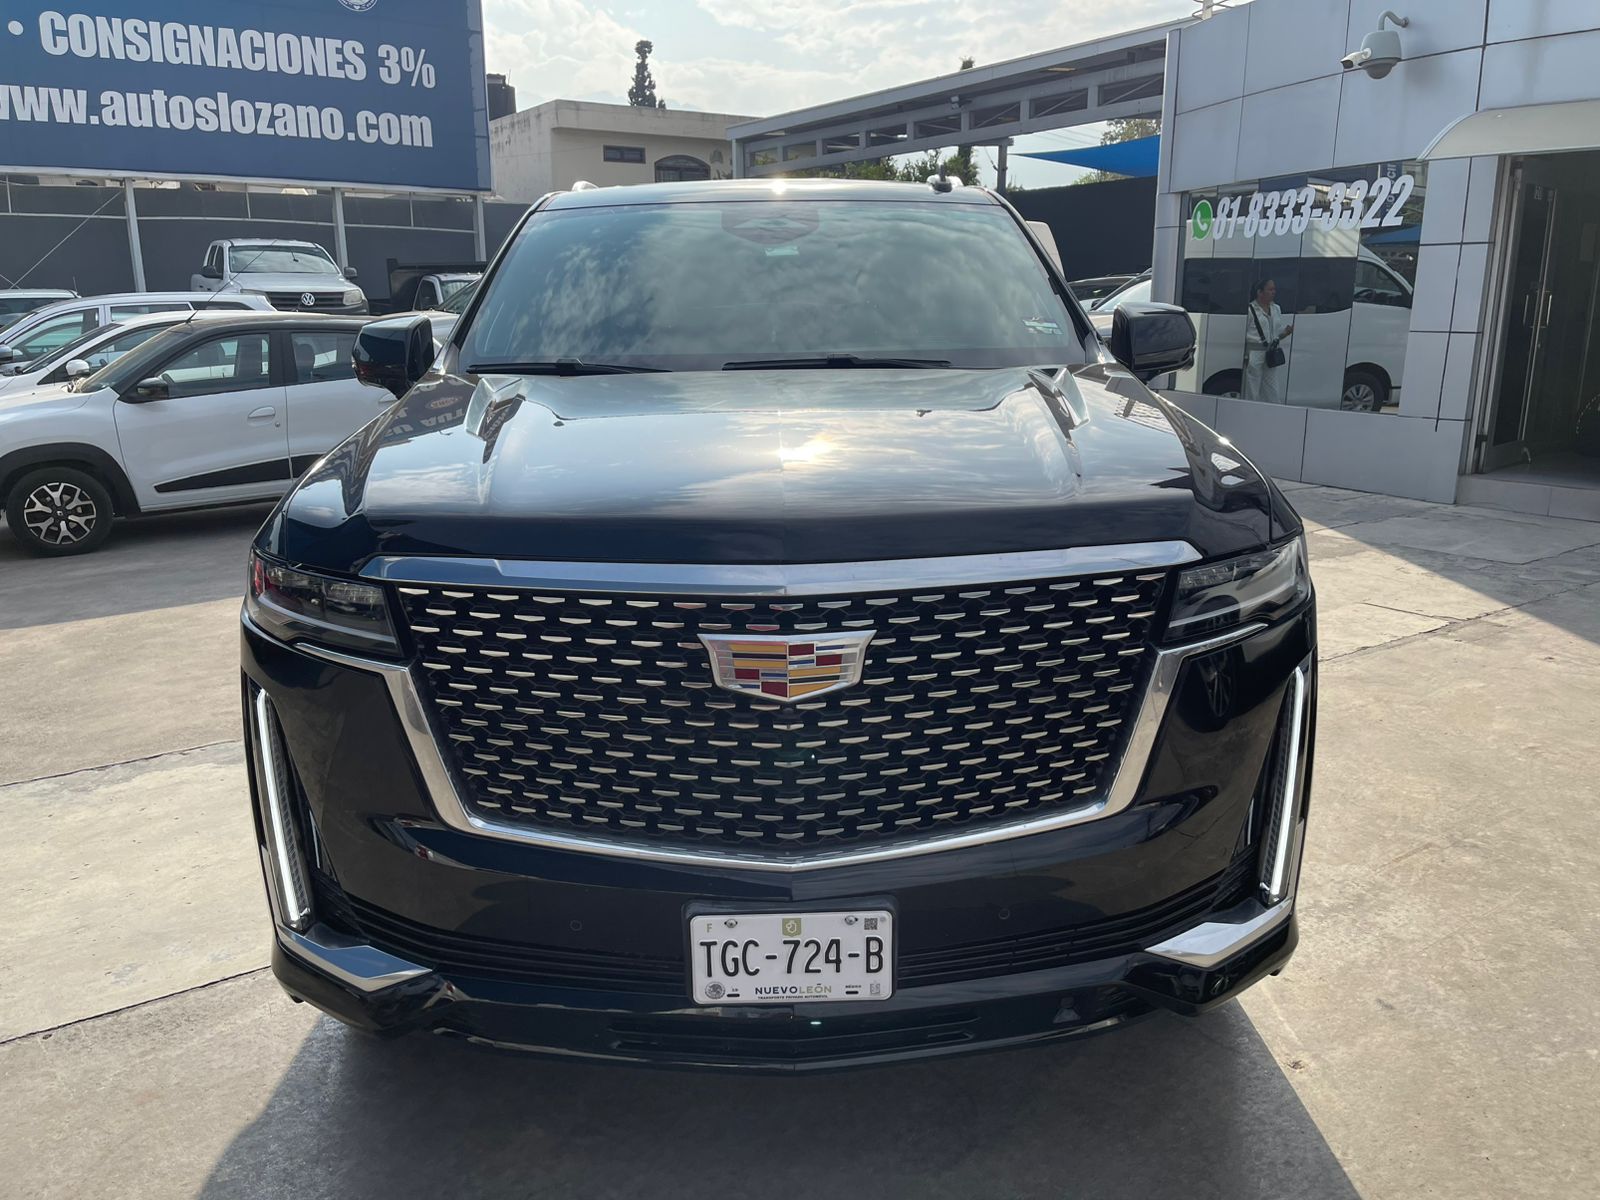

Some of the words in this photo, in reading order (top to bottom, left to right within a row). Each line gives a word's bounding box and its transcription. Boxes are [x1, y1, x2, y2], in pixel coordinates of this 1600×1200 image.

[39, 11, 367, 81] CONSIGNACIONES
[378, 44, 436, 88] 3%
[0, 84, 433, 147] ww.autoslozano.com
[1212, 174, 1414, 240] 81-8333-3322
[699, 936, 884, 978] TGC-724-B
